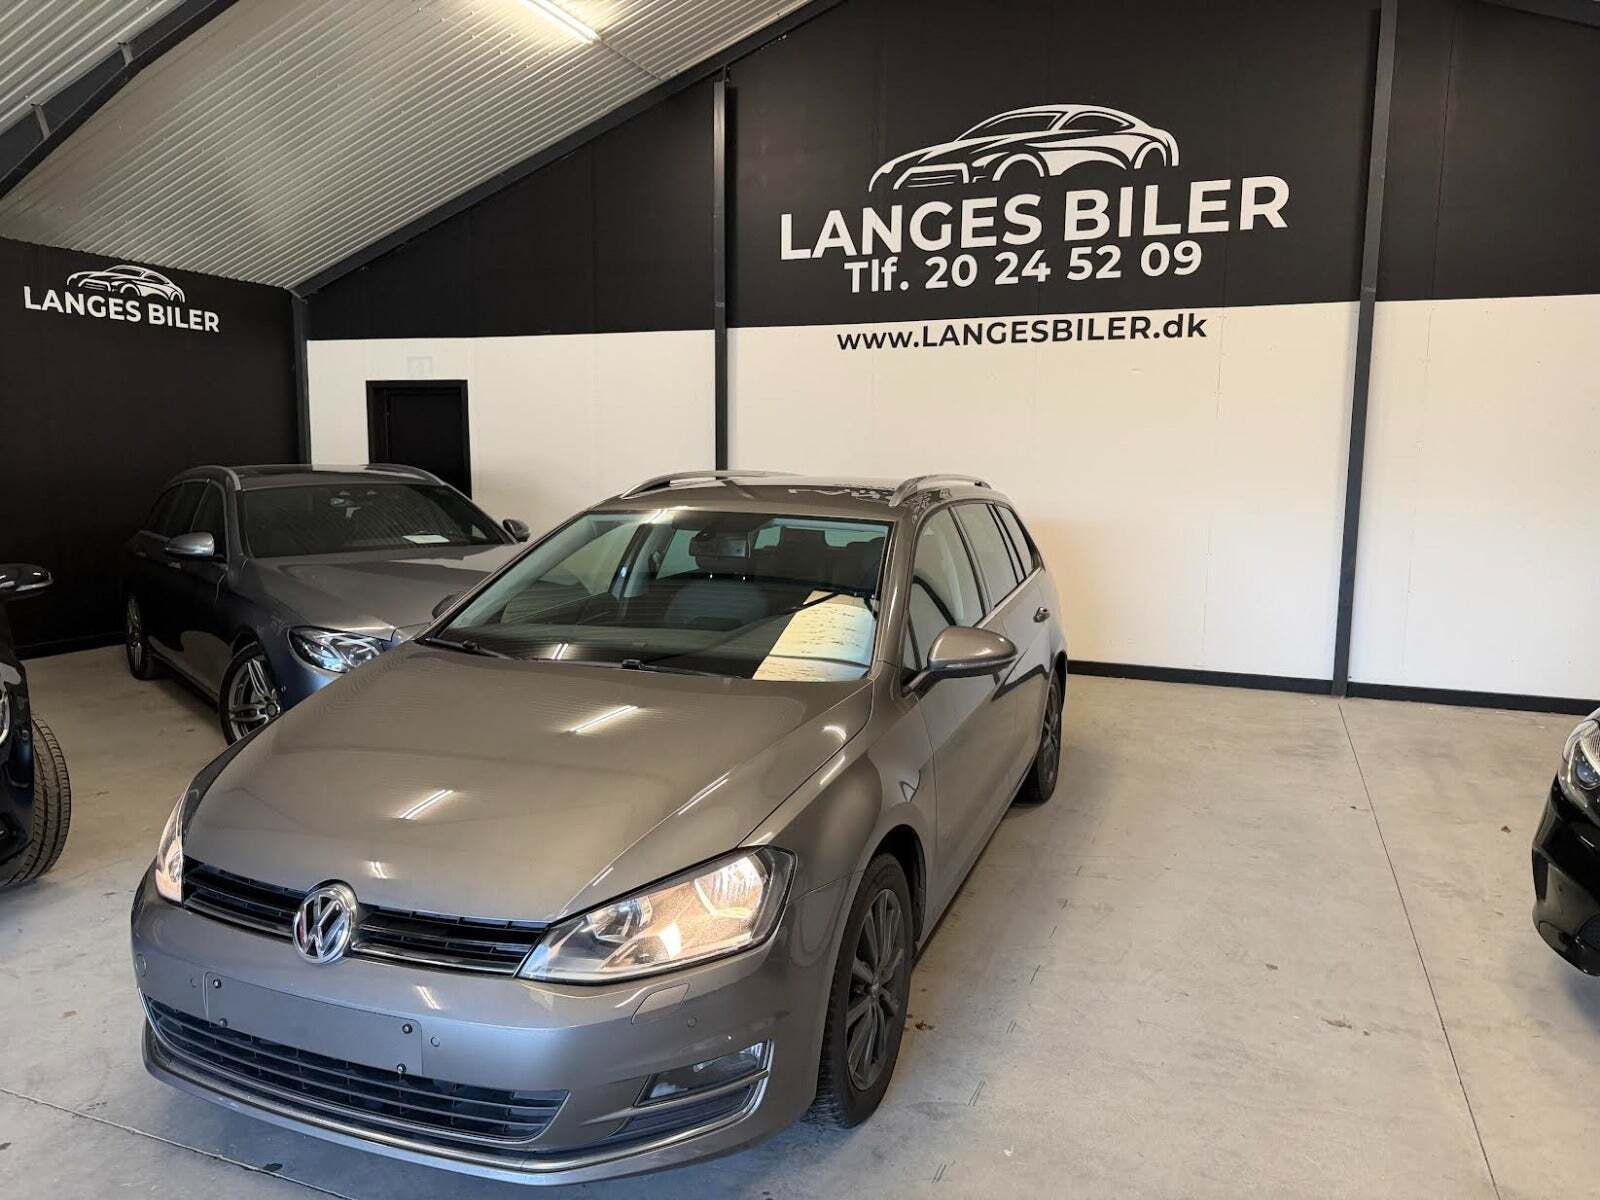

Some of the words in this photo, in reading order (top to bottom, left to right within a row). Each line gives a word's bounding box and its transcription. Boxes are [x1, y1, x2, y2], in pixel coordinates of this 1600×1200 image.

[780, 193, 1043, 261] LANGES
[1063, 175, 1290, 241] BILER
[843, 256, 909, 293] Tlf.
[925, 253, 978, 289] 20
[994, 249, 1051, 285] 24
[1066, 244, 1122, 281] 52
[1140, 240, 1202, 277] 09
[23, 285, 142, 323] LANGES
[147, 302, 220, 333] BILER
[836, 312, 1207, 351] www.LANGESBILER.dk
